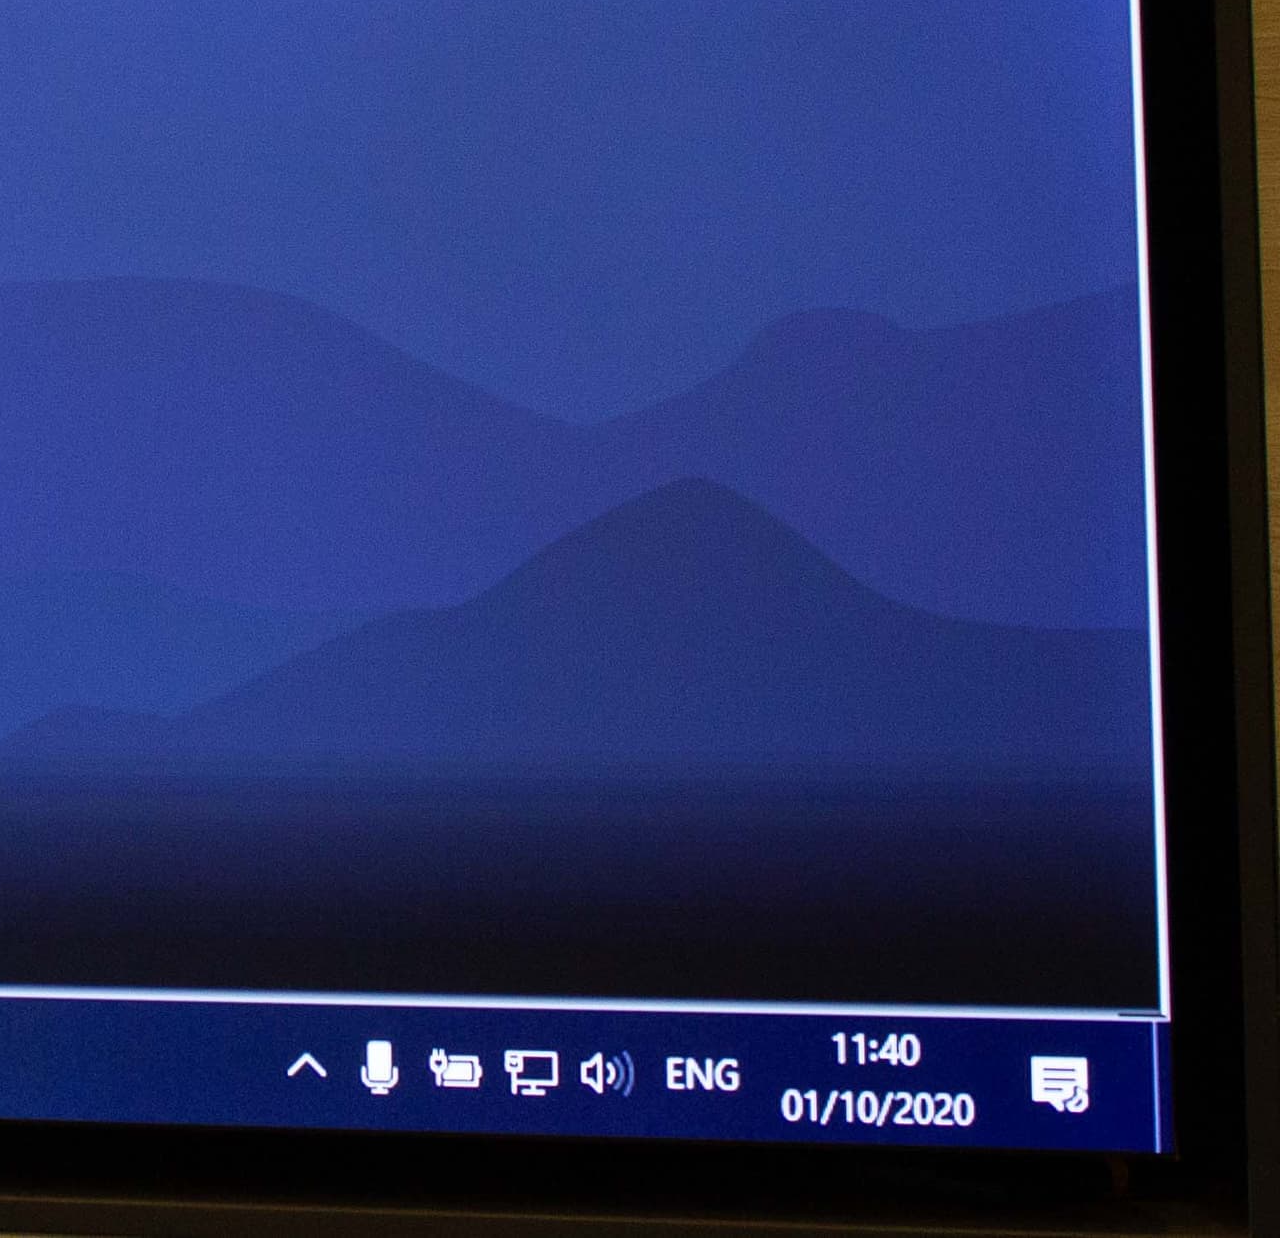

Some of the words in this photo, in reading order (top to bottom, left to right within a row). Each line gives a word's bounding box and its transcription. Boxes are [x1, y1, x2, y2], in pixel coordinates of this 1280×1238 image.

[831, 1031, 920, 1068] 11:40
[666, 1057, 740, 1092] ENG
[781, 1089, 975, 1127] 01/10/2020
